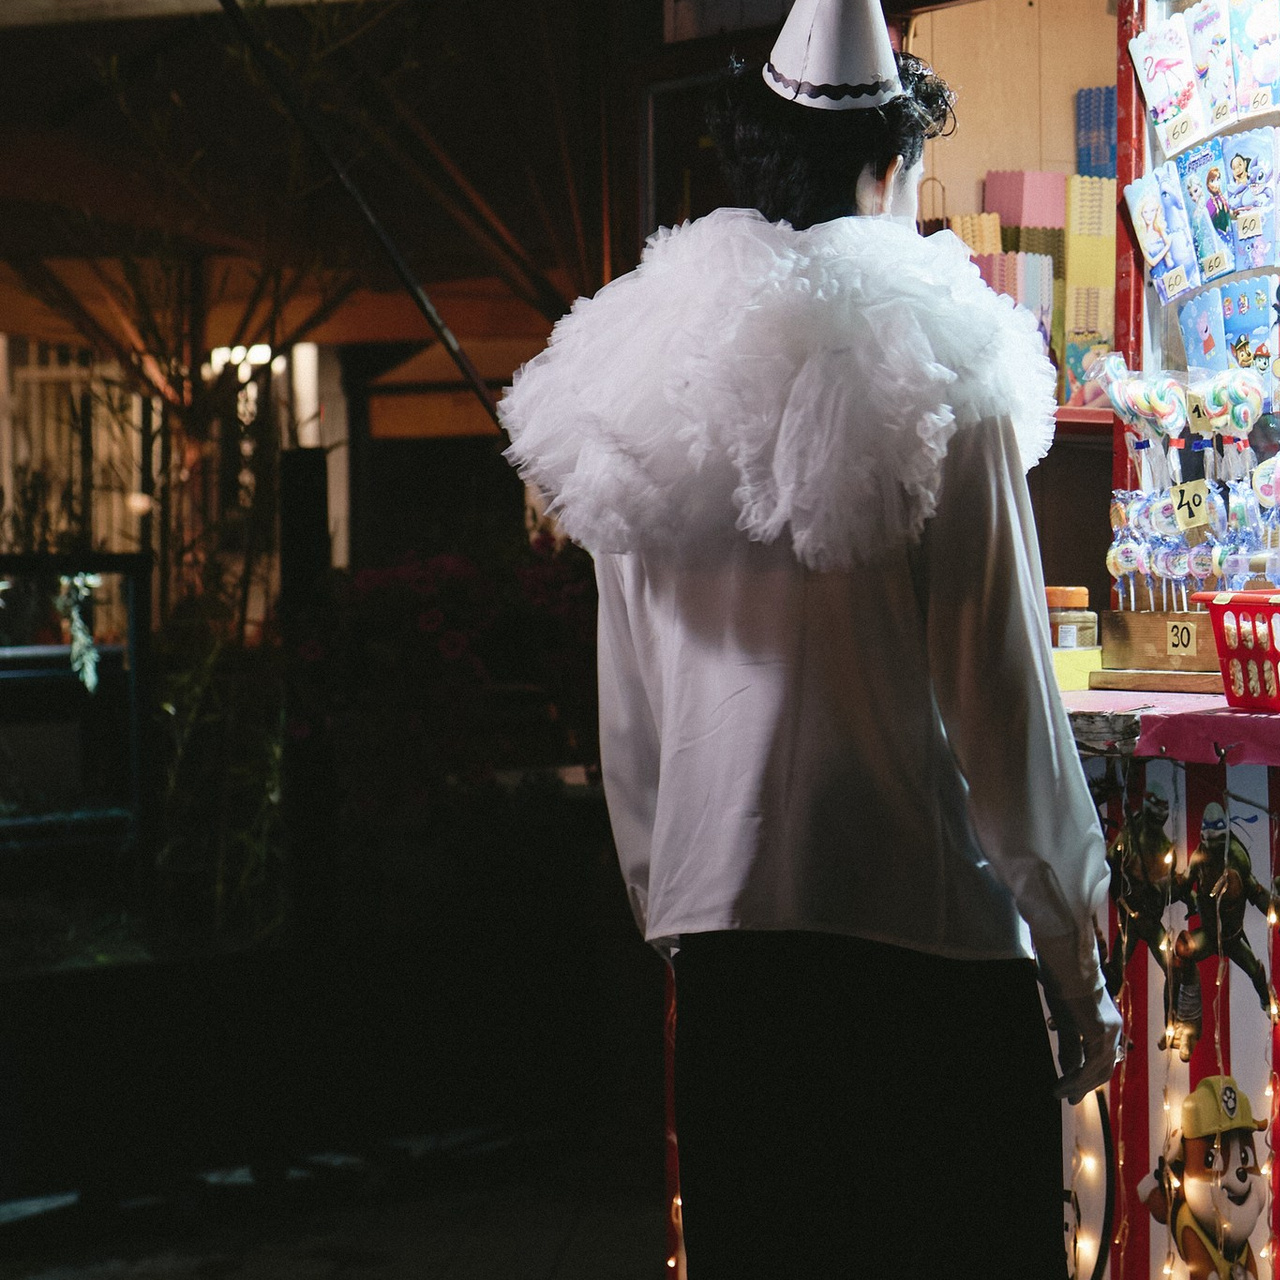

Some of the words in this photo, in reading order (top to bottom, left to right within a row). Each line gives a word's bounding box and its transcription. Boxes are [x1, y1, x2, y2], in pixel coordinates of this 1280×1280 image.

[1252, 93, 1269, 110] 60
[1215, 104, 1228, 120] 60
[1172, 121, 1188, 141] 60
[1242, 218, 1256, 235] 60
[1207, 256, 1221, 271] 60
[1168, 274, 1182, 291] 60
[1177, 489, 1202, 518] 40
[1171, 625, 1191, 648] 30
